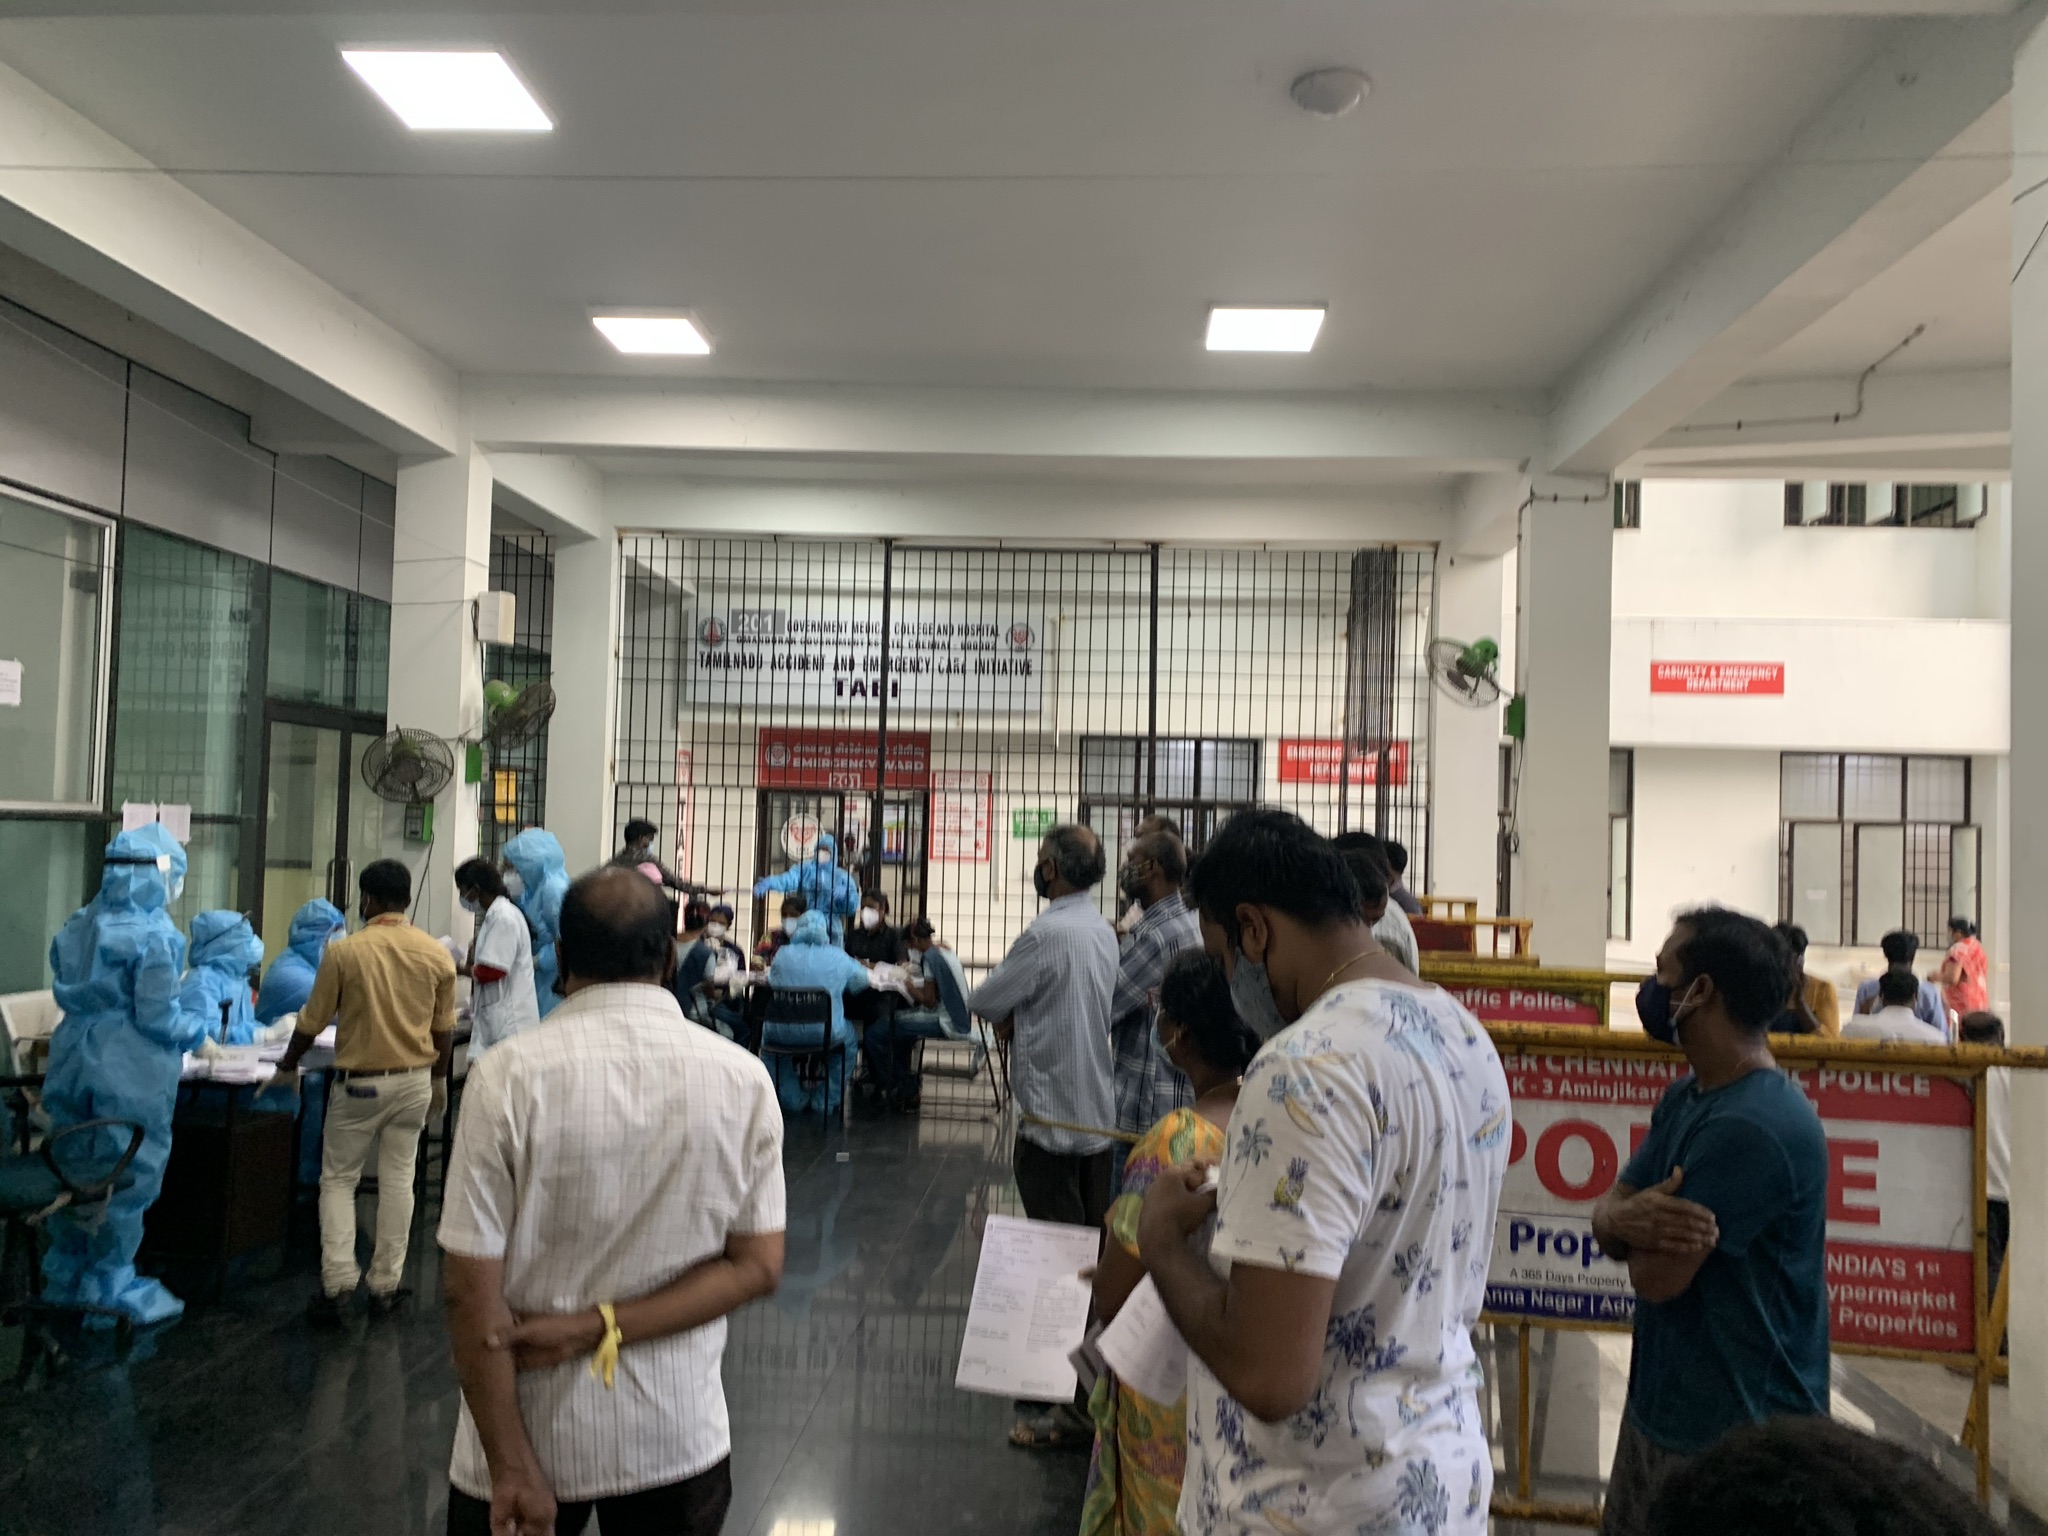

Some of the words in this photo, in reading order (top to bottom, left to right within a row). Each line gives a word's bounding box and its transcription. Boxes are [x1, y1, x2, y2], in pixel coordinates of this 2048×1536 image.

[738, 613, 773, 633] 201
[787, 619, 849, 634] GOVERNMENT
[894, 622, 934, 635] COLLEGE
[936, 623, 954, 636] AND
[957, 624, 1000, 637] HOSPITAL
[700, 651, 763, 670] TAMILNADU
[771, 653, 826, 672] ACCIDENT
[833, 654, 855, 672] AND
[863, 655, 930, 674] EMRGENCY
[974, 657, 1033, 676] INITIATIVE
[1719, 665, 1779, 681] EMERGENCY
[793, 757, 877, 770] EMERGENCY
[884, 760, 924, 772] WARD
[1510, 990, 1577, 1013] Police
[1512, 1077, 1525, 1094] K
[1543, 1079, 1553, 1095] 3
[1818, 1068, 1931, 1097] POLICE
[1509, 1268, 1519, 1279] A
[1521, 1270, 1543, 1282] 365
[1545, 1271, 1575, 1286] Days
[1577, 1273, 1627, 1289] Property
[1531, 1288, 1585, 1312] Nagar
[1838, 1305, 1959, 1339] Properties
